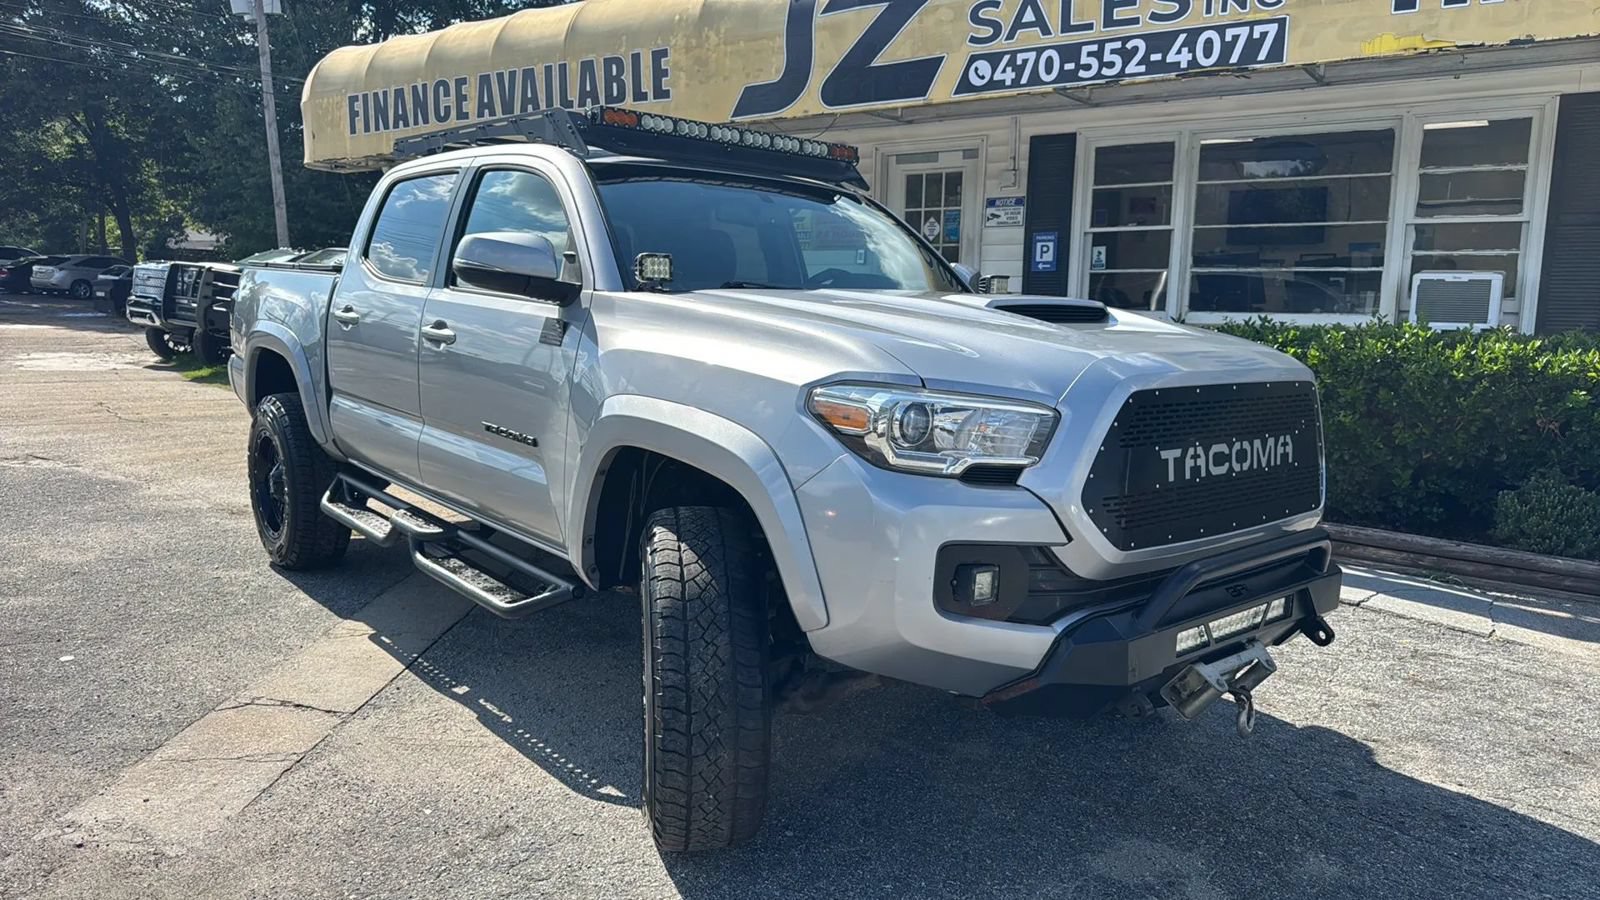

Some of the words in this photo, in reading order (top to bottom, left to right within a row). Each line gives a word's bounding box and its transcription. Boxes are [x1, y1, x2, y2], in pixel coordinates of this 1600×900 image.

[967, 0, 1193, 48] SALES
[729, 0, 948, 120] JZ
[992, 23, 1279, 87] 470-552-4077
[347, 76, 470, 137] FINANCE
[476, 47, 673, 119] AVAILABLE
[994, 198, 1016, 207] NOTICE
[1040, 244, 1050, 259] P
[1159, 434, 1293, 482] TACOMA
